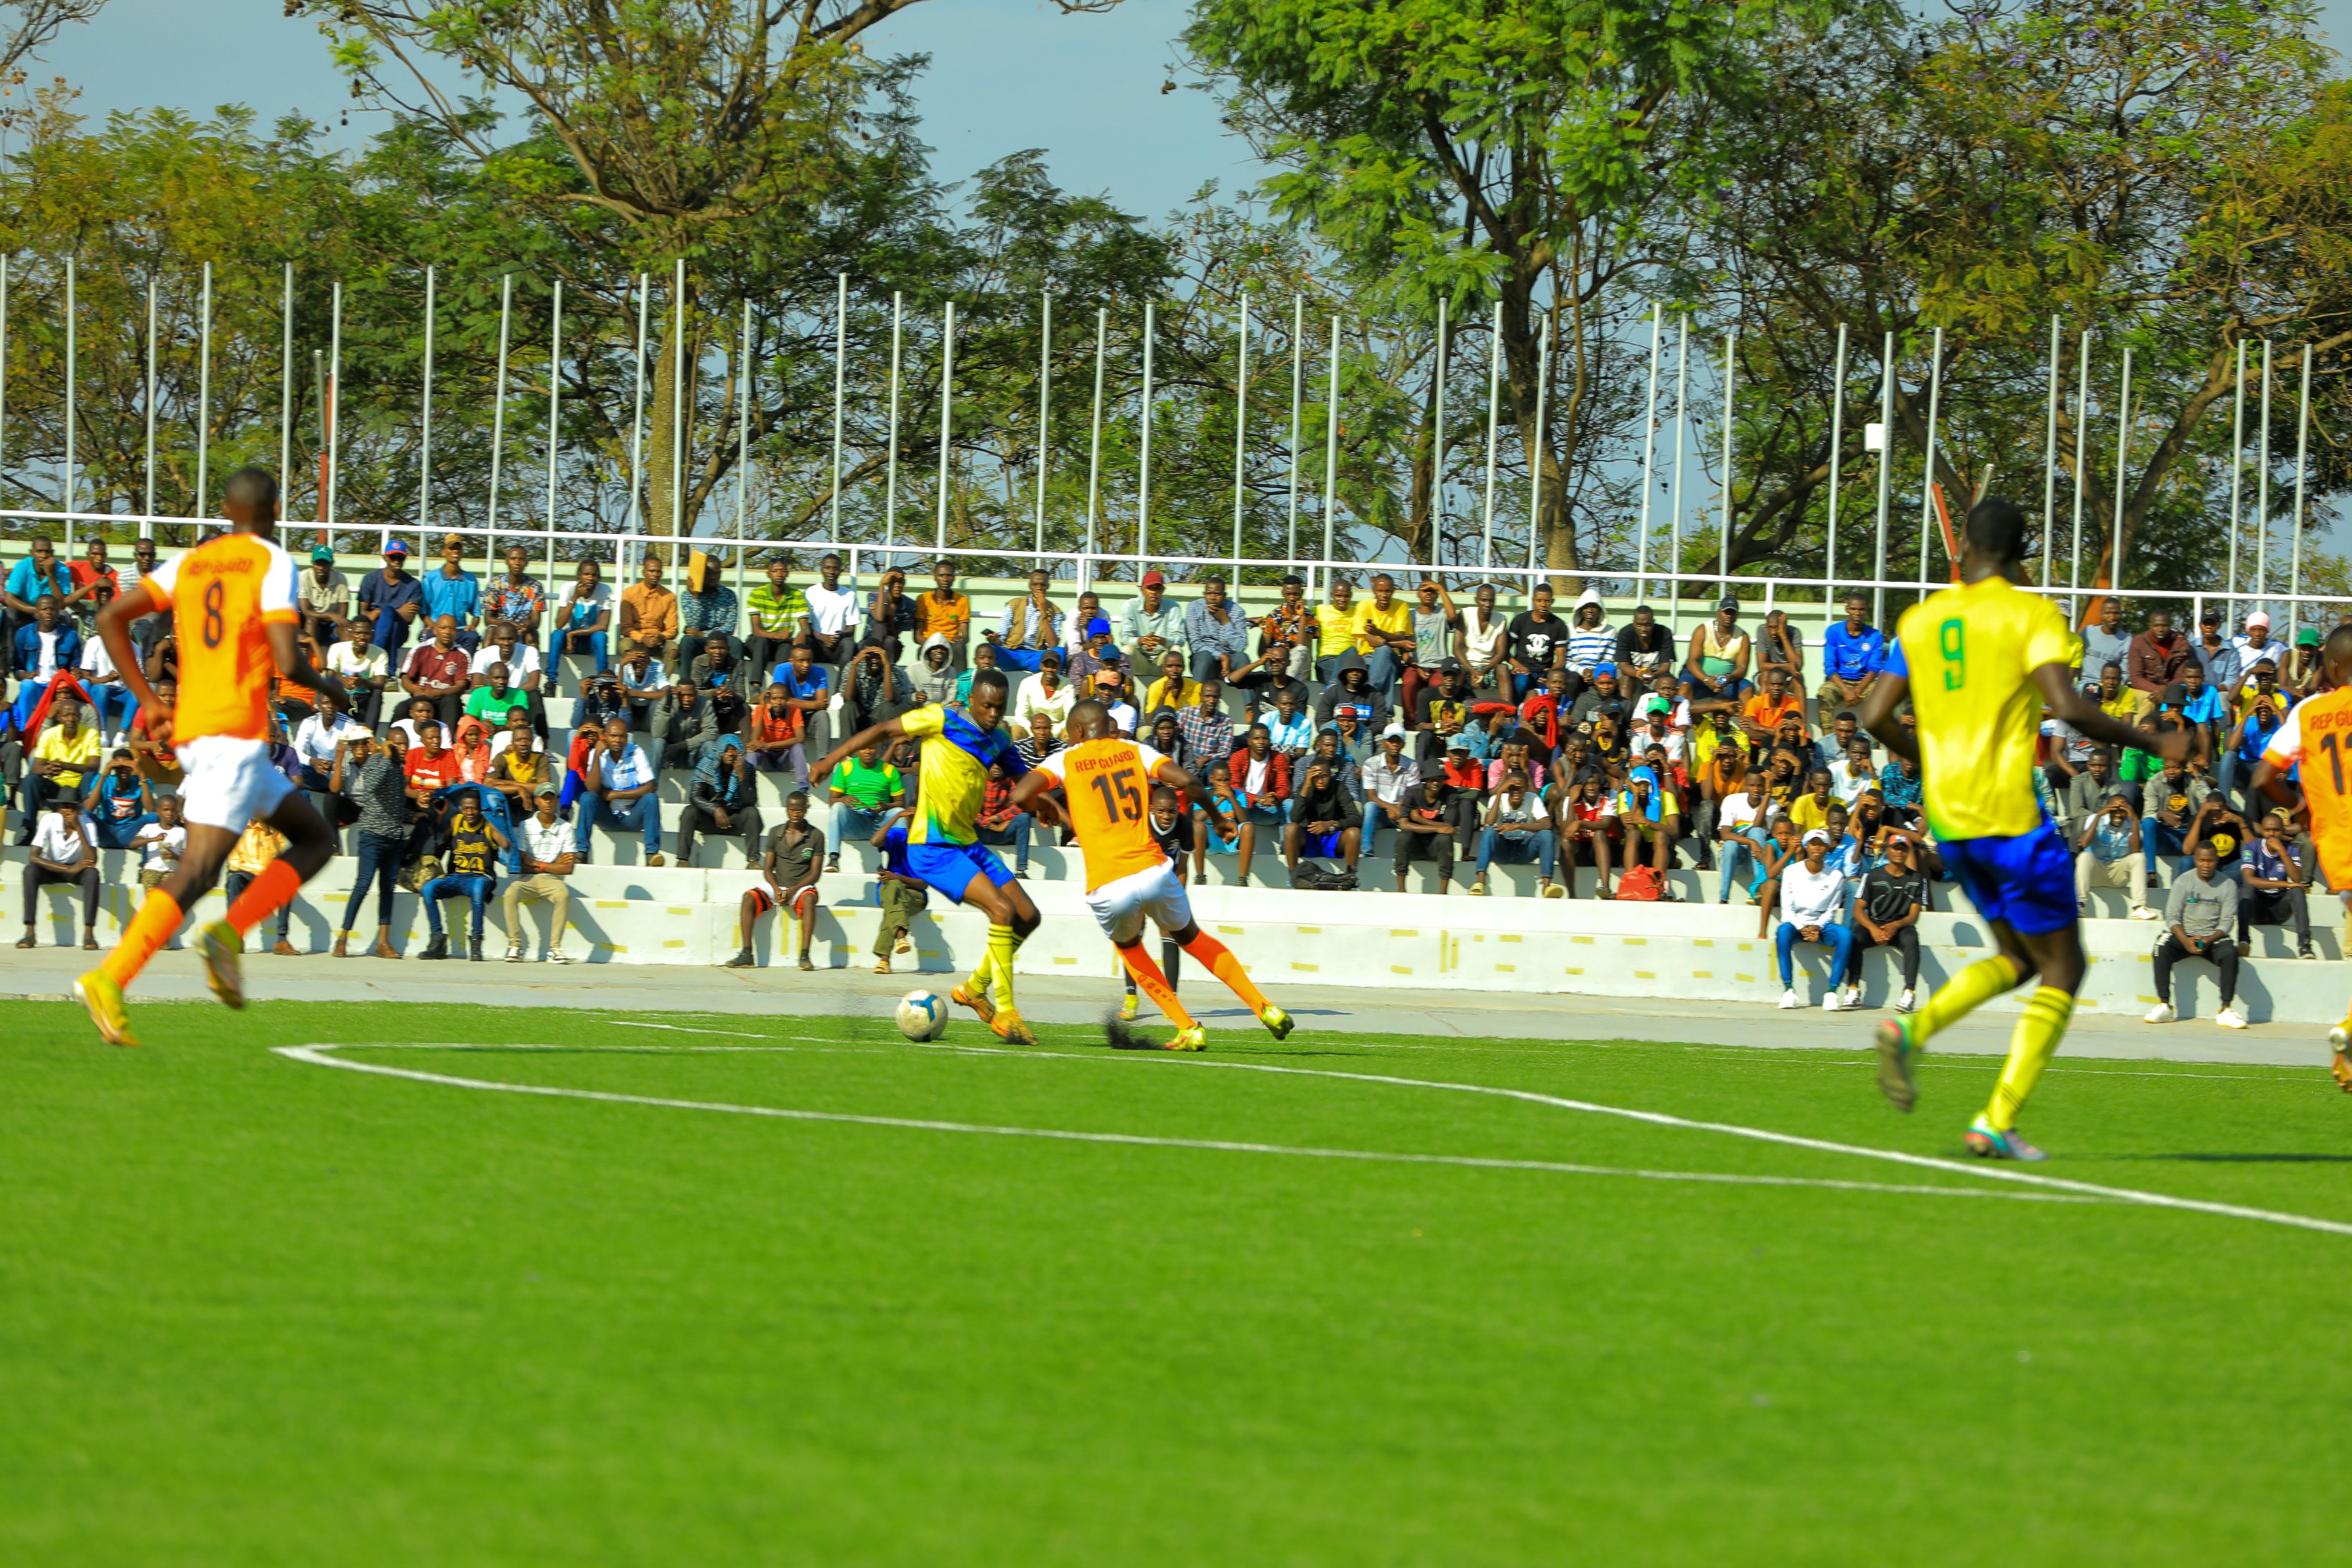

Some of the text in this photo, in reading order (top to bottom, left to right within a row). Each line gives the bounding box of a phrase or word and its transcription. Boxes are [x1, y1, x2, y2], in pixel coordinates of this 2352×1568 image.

[204, 579, 223, 649] 8
[1941, 619, 1964, 690] 9
[2310, 712, 2333, 730] REP
[1075, 750, 1134, 772] REP GUARD
[1091, 767, 1142, 823] 15
